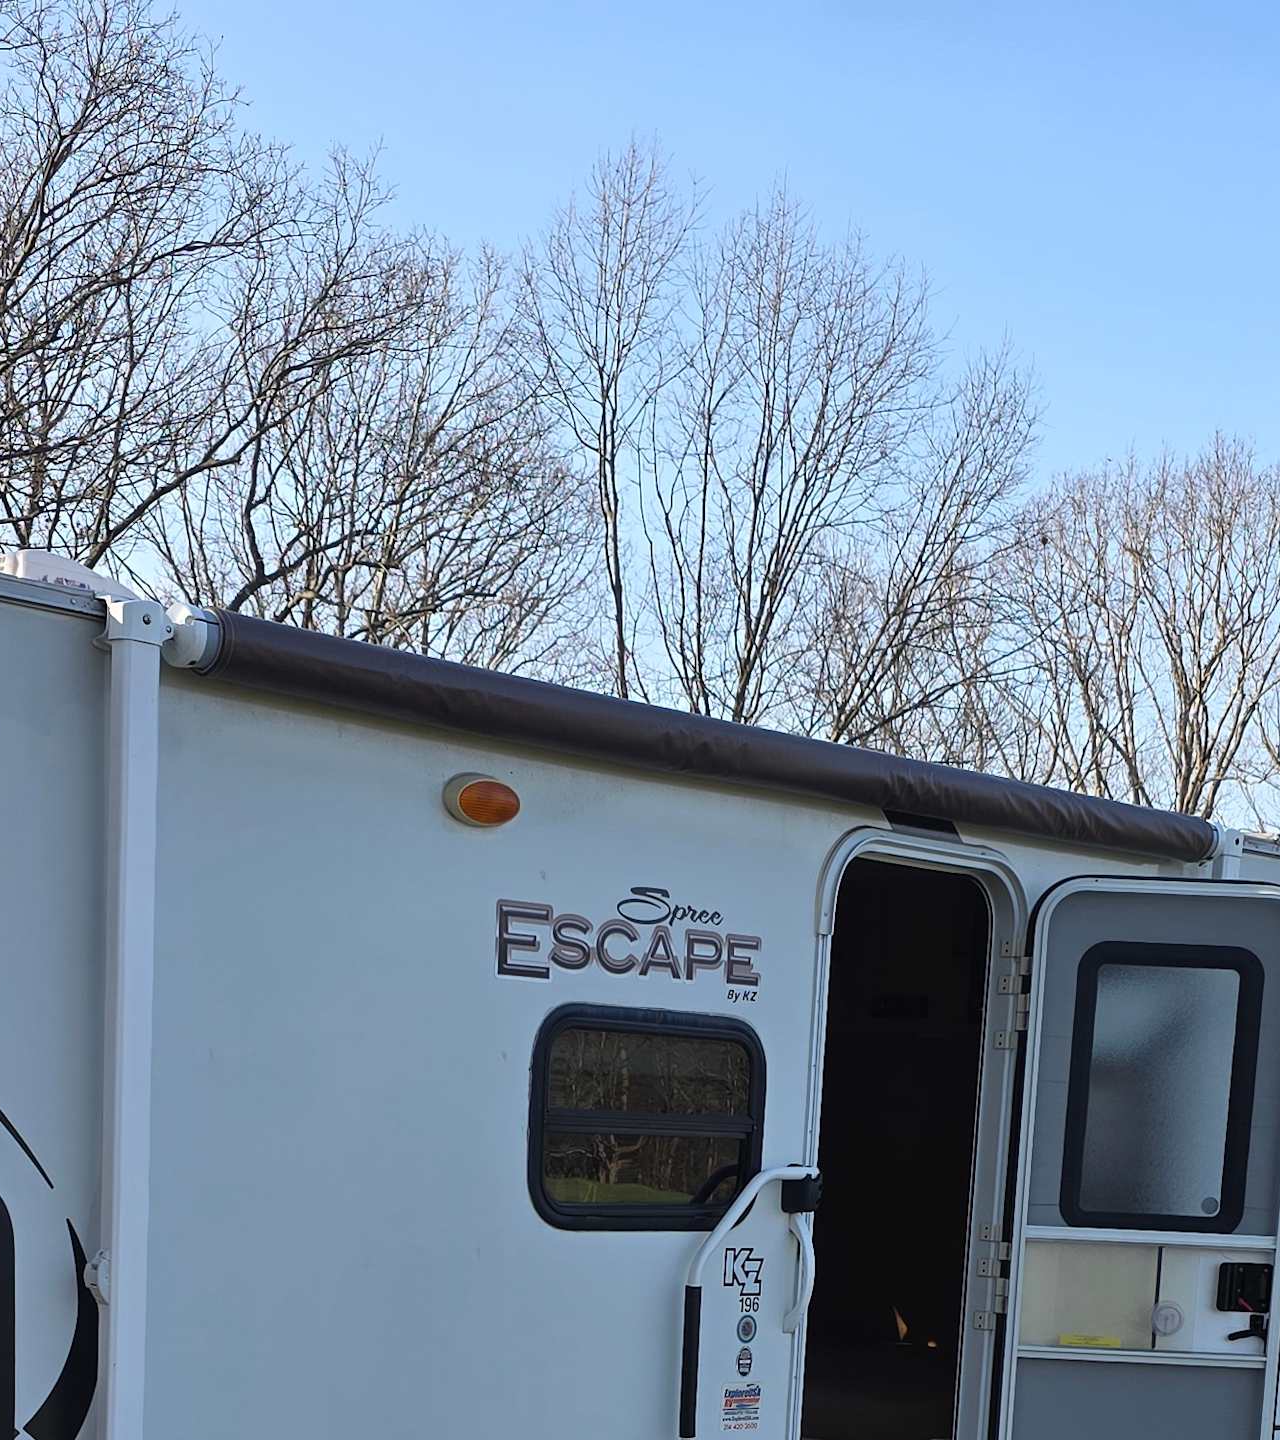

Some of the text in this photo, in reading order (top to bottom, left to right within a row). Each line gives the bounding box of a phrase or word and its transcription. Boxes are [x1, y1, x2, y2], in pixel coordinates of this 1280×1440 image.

[617, 886, 724, 926] Spree
[495, 898, 762, 986] ESCAPE
[727, 989, 758, 1003] By KZ
[723, 1247, 764, 1296] KZ
[739, 1296, 760, 1313] 196
